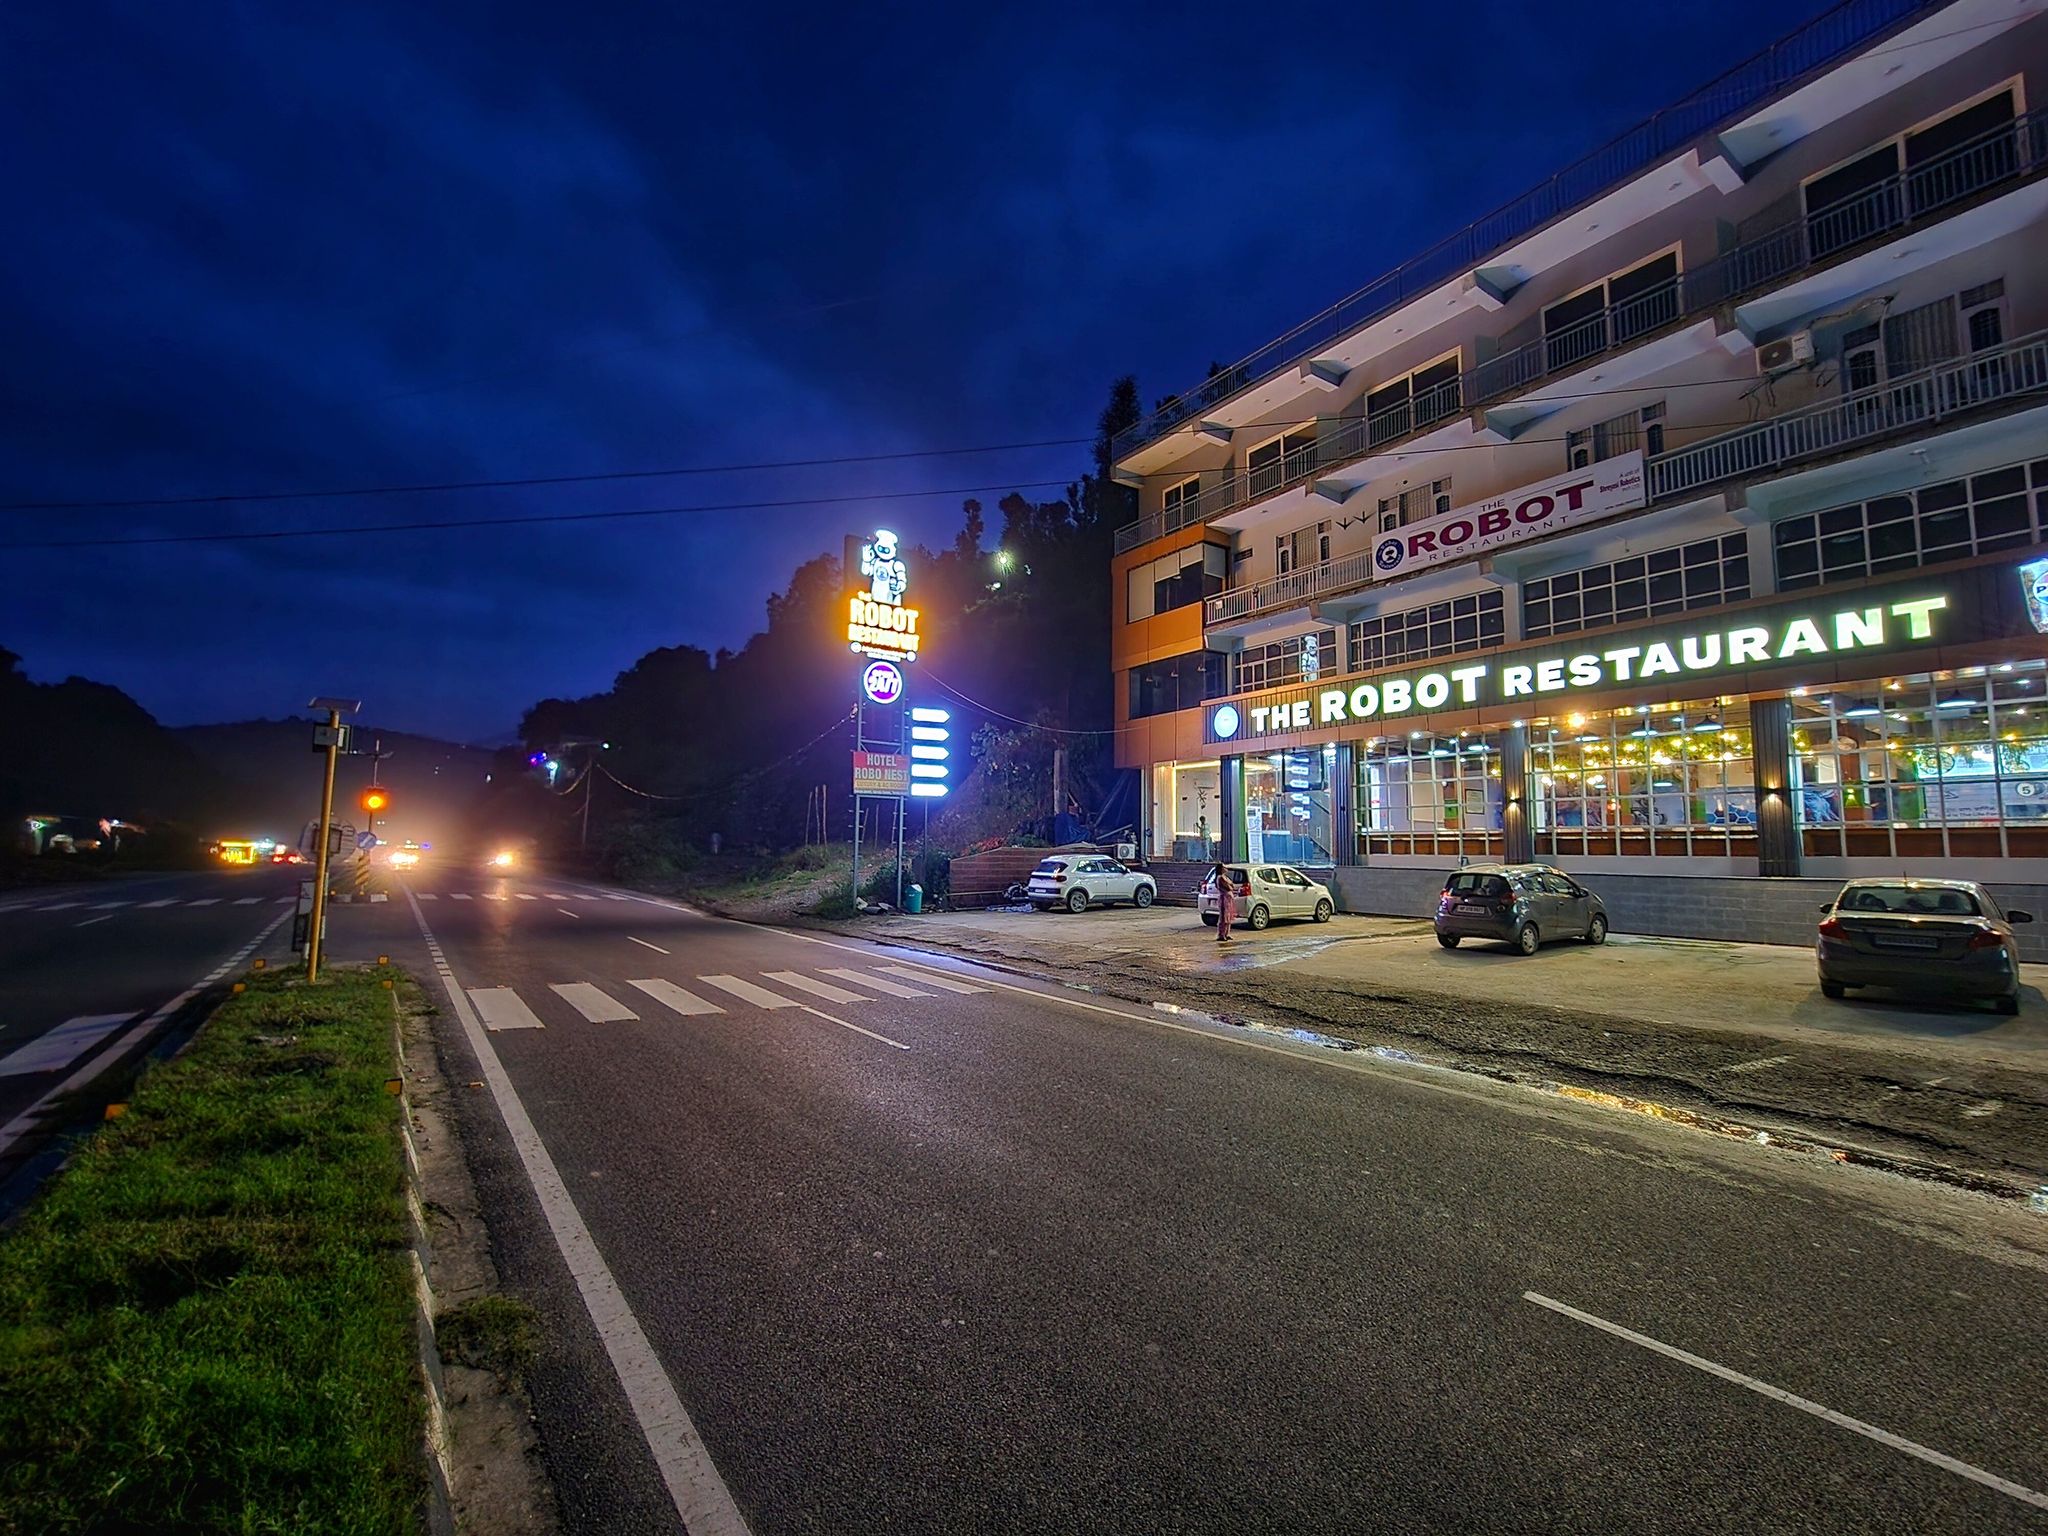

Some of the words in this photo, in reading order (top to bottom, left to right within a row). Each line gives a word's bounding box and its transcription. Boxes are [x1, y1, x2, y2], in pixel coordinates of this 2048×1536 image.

[1480, 499, 1506, 512] THE
[1408, 480, 1594, 558] ROBOT
[1429, 516, 1569, 561] RESTAURANT
[850, 598, 919, 634] ROBOT
[1250, 700, 1310, 732] THE
[1320, 665, 1487, 723] ROBOT
[1503, 596, 1948, 698] RESTAURANT
[867, 753, 897, 766] HOTEL
[854, 767, 882, 779] ROBO
[885, 769, 908, 780] NEST
[2022, 786, 2031, 794] 5
